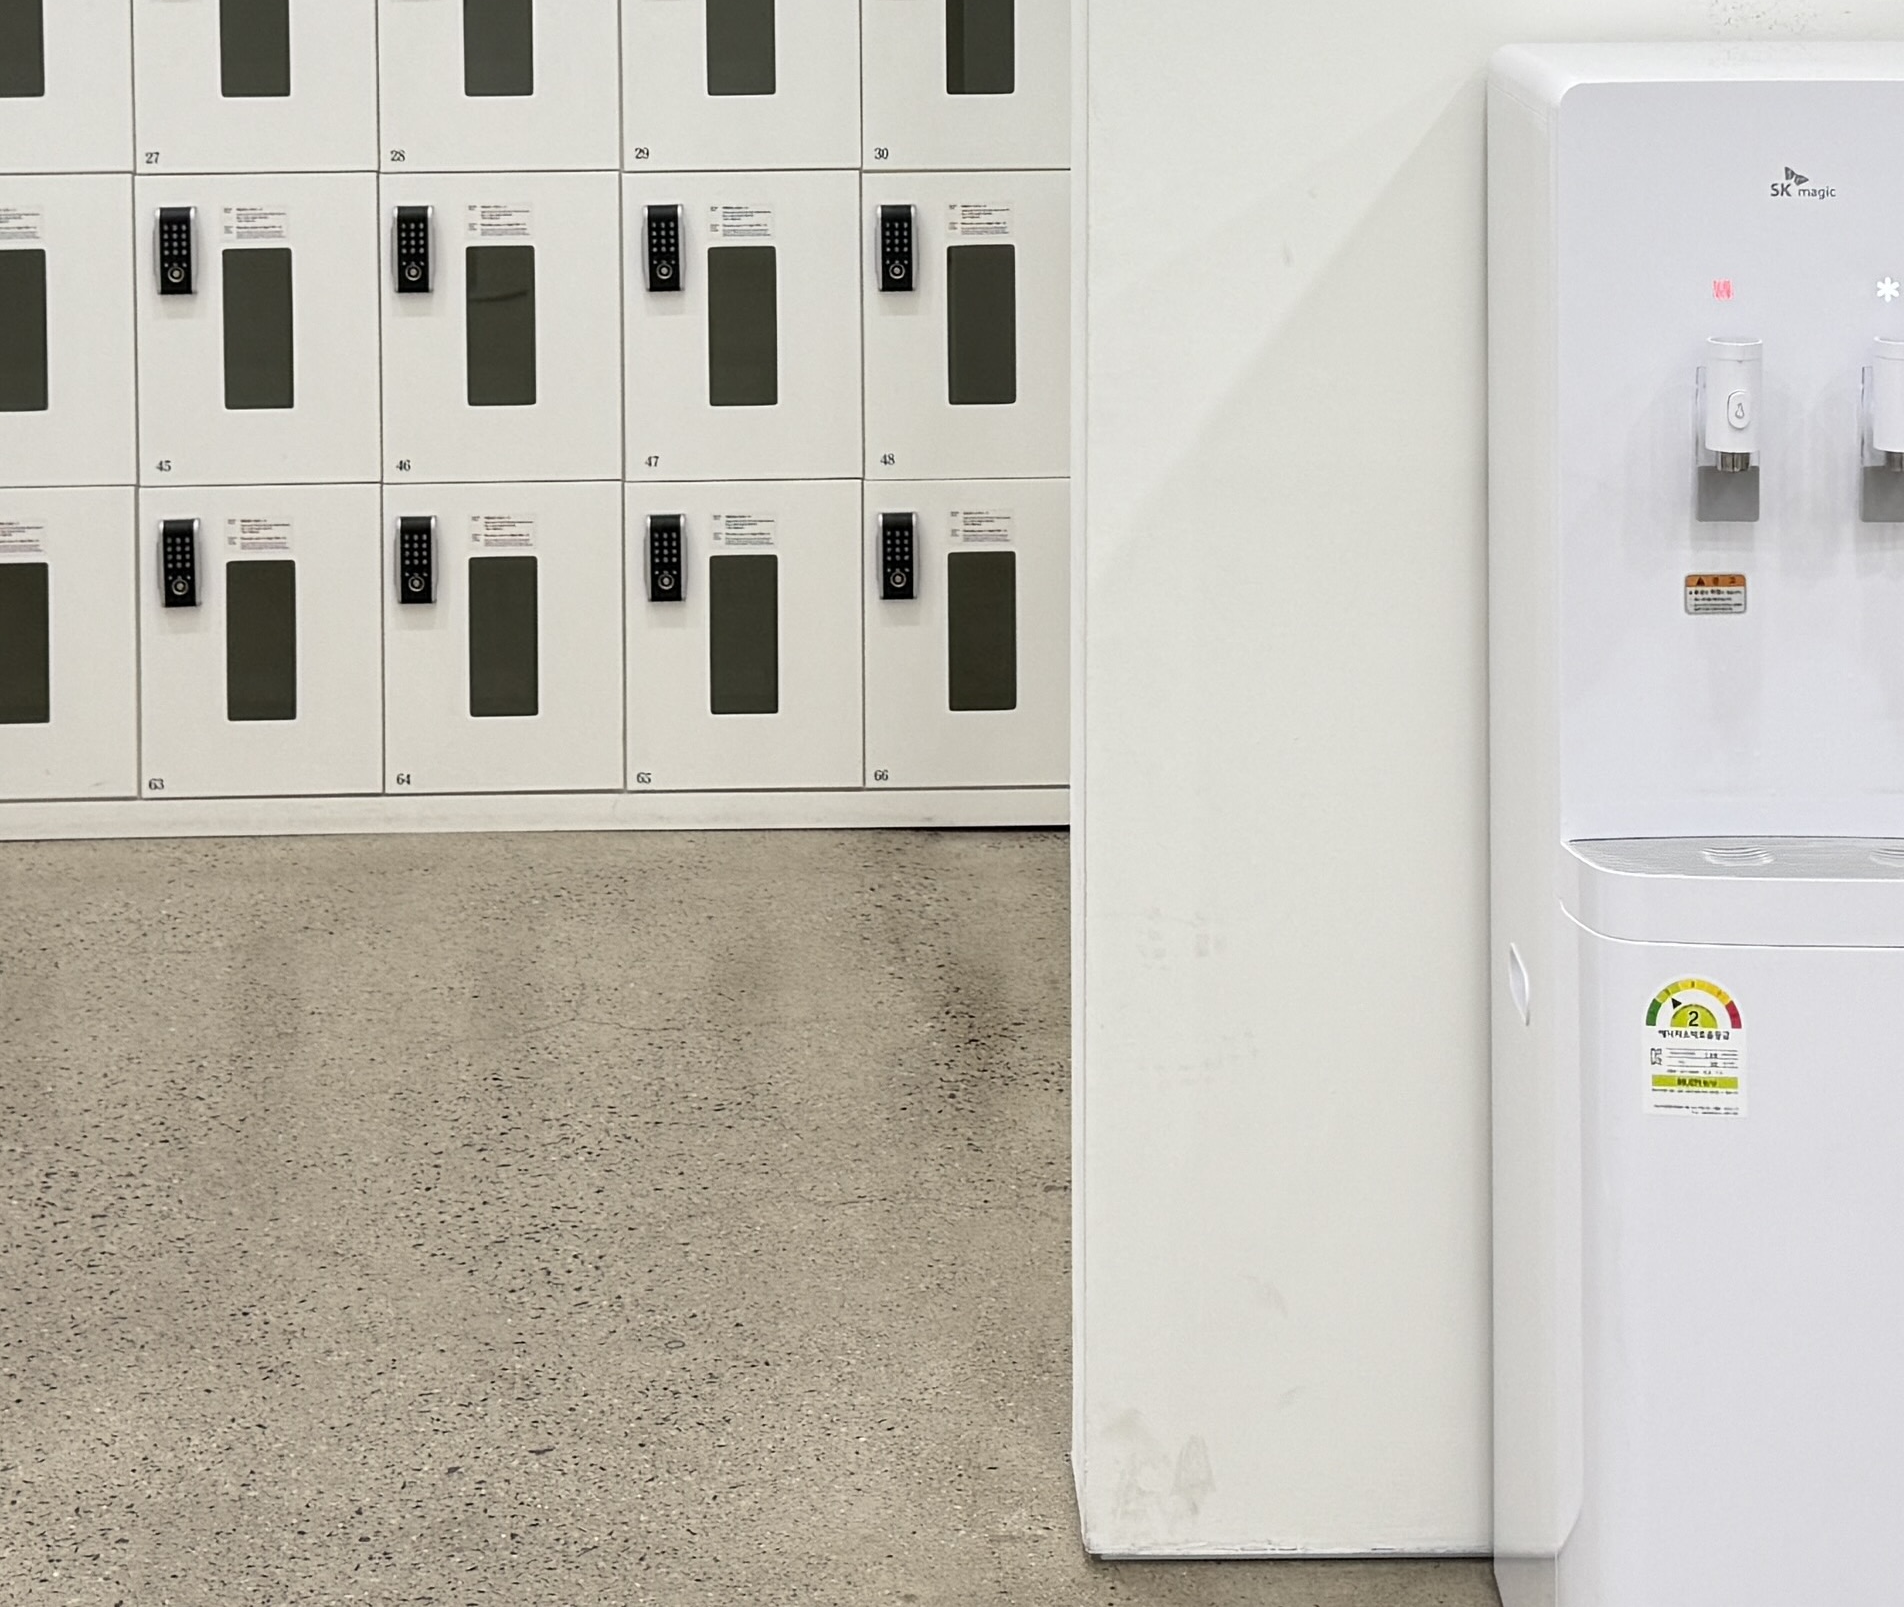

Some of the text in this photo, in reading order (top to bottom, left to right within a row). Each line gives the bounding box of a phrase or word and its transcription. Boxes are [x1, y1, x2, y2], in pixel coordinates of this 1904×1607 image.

[145, 151, 160, 165] 27
[390, 149, 406, 162] 28
[634, 147, 650, 160] 29
[874, 147, 889, 160] 30
[1770, 182, 1836, 200] SK magic
[156, 459, 172, 472] 45
[396, 459, 411, 472] 46
[645, 455, 660, 468] 47
[880, 453, 896, 466] 48
[396, 773, 411, 786] 64
[636, 771, 652, 784] 65
[873, 769, 889, 782] 66
[148, 778, 165, 791] 63
[1688, 1010, 1700, 1027] 2
